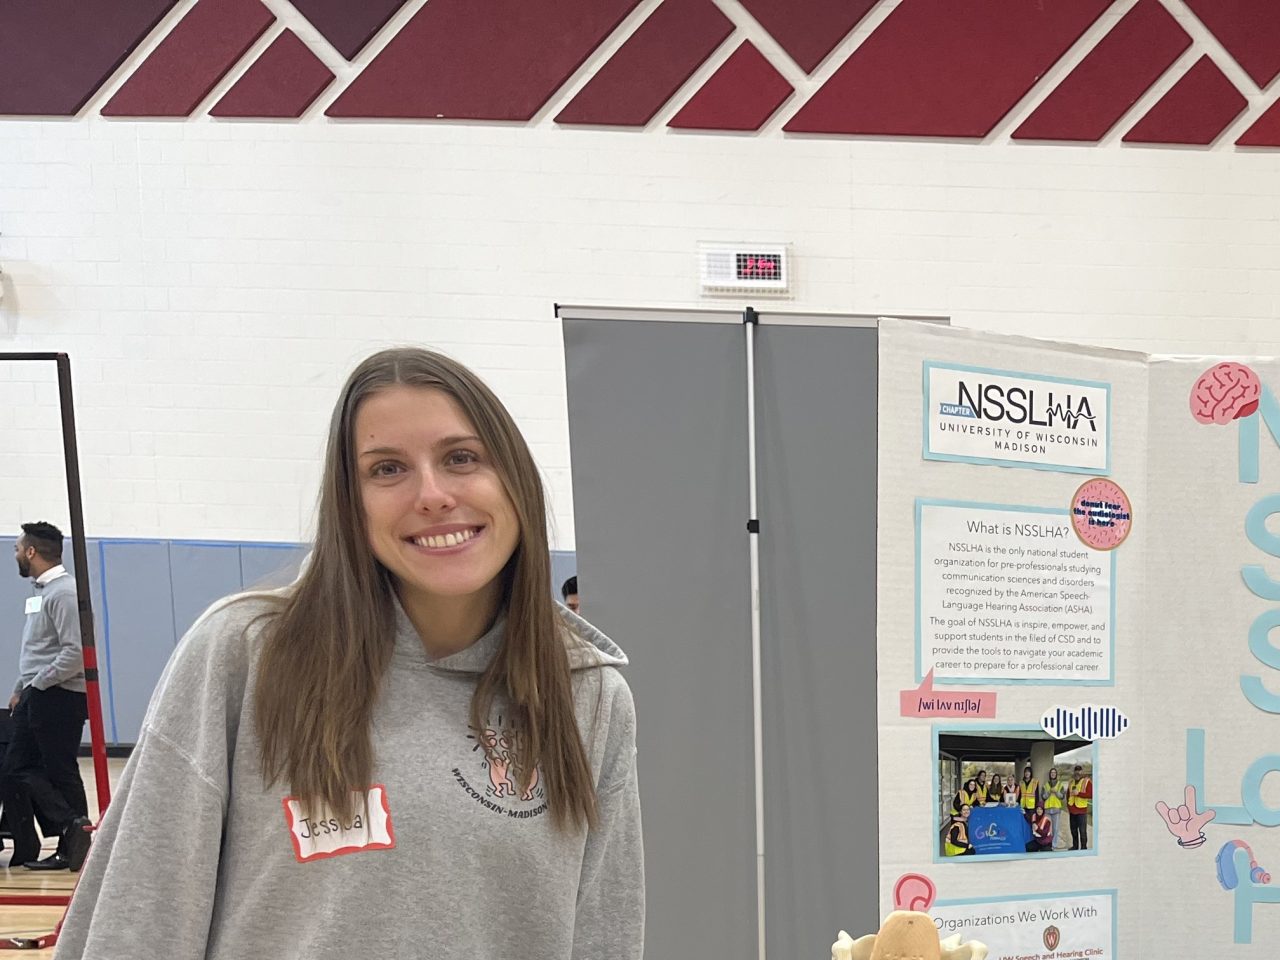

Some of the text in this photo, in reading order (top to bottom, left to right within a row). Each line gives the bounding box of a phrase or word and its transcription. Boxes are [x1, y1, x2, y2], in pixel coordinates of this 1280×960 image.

[942, 404, 971, 416] CHAPTER
[958, 380, 1097, 432] NSSLHA
[939, 422, 1097, 446] UNIVERSITY OF WISCONSIN
[994, 440, 1045, 453] MADISON
[1073, 507, 1130, 522] the audiologist
[966, 520, 1072, 538] What is NSSLHA?
[948, 542, 1088, 559] NSSLHA is the only national student
[451, 767, 548, 819] WISCONSIN-MADISON
[1017, 910, 1036, 922] We
[1039, 907, 1069, 920] Work
[1071, 905, 1097, 918] With
[1042, 952, 1054, 960] and
[1056, 950, 1083, 958] Hearing
[1084, 948, 1103, 956] Clinic
